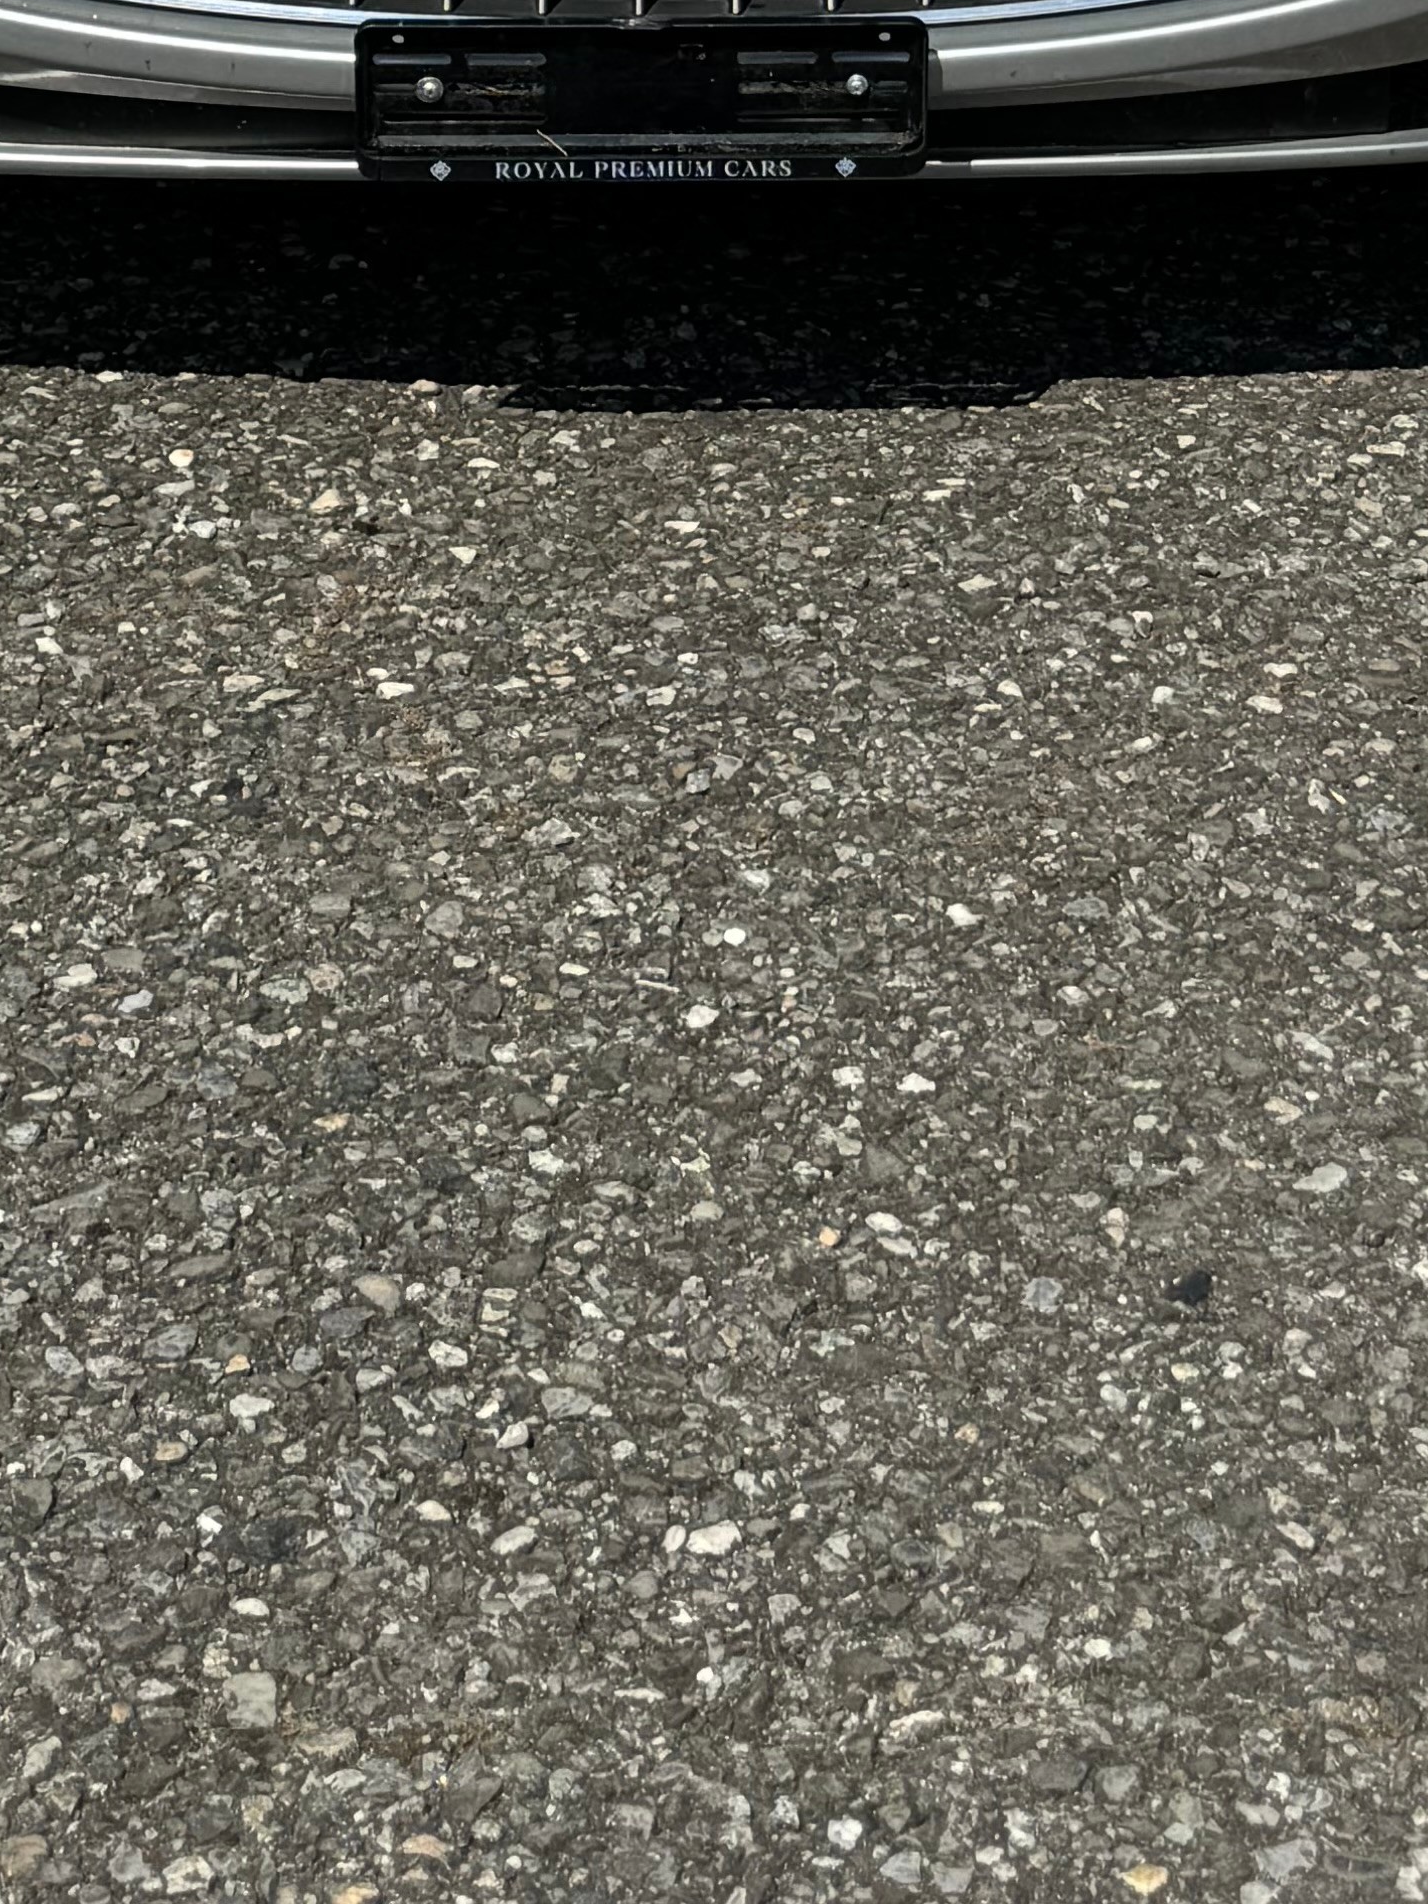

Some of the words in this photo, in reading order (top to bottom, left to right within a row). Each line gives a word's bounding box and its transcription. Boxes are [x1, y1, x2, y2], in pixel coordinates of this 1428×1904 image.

[495, 161, 583, 180] ROYAL
[595, 160, 713, 179] PREMIUM
[724, 159, 792, 178] CARS
